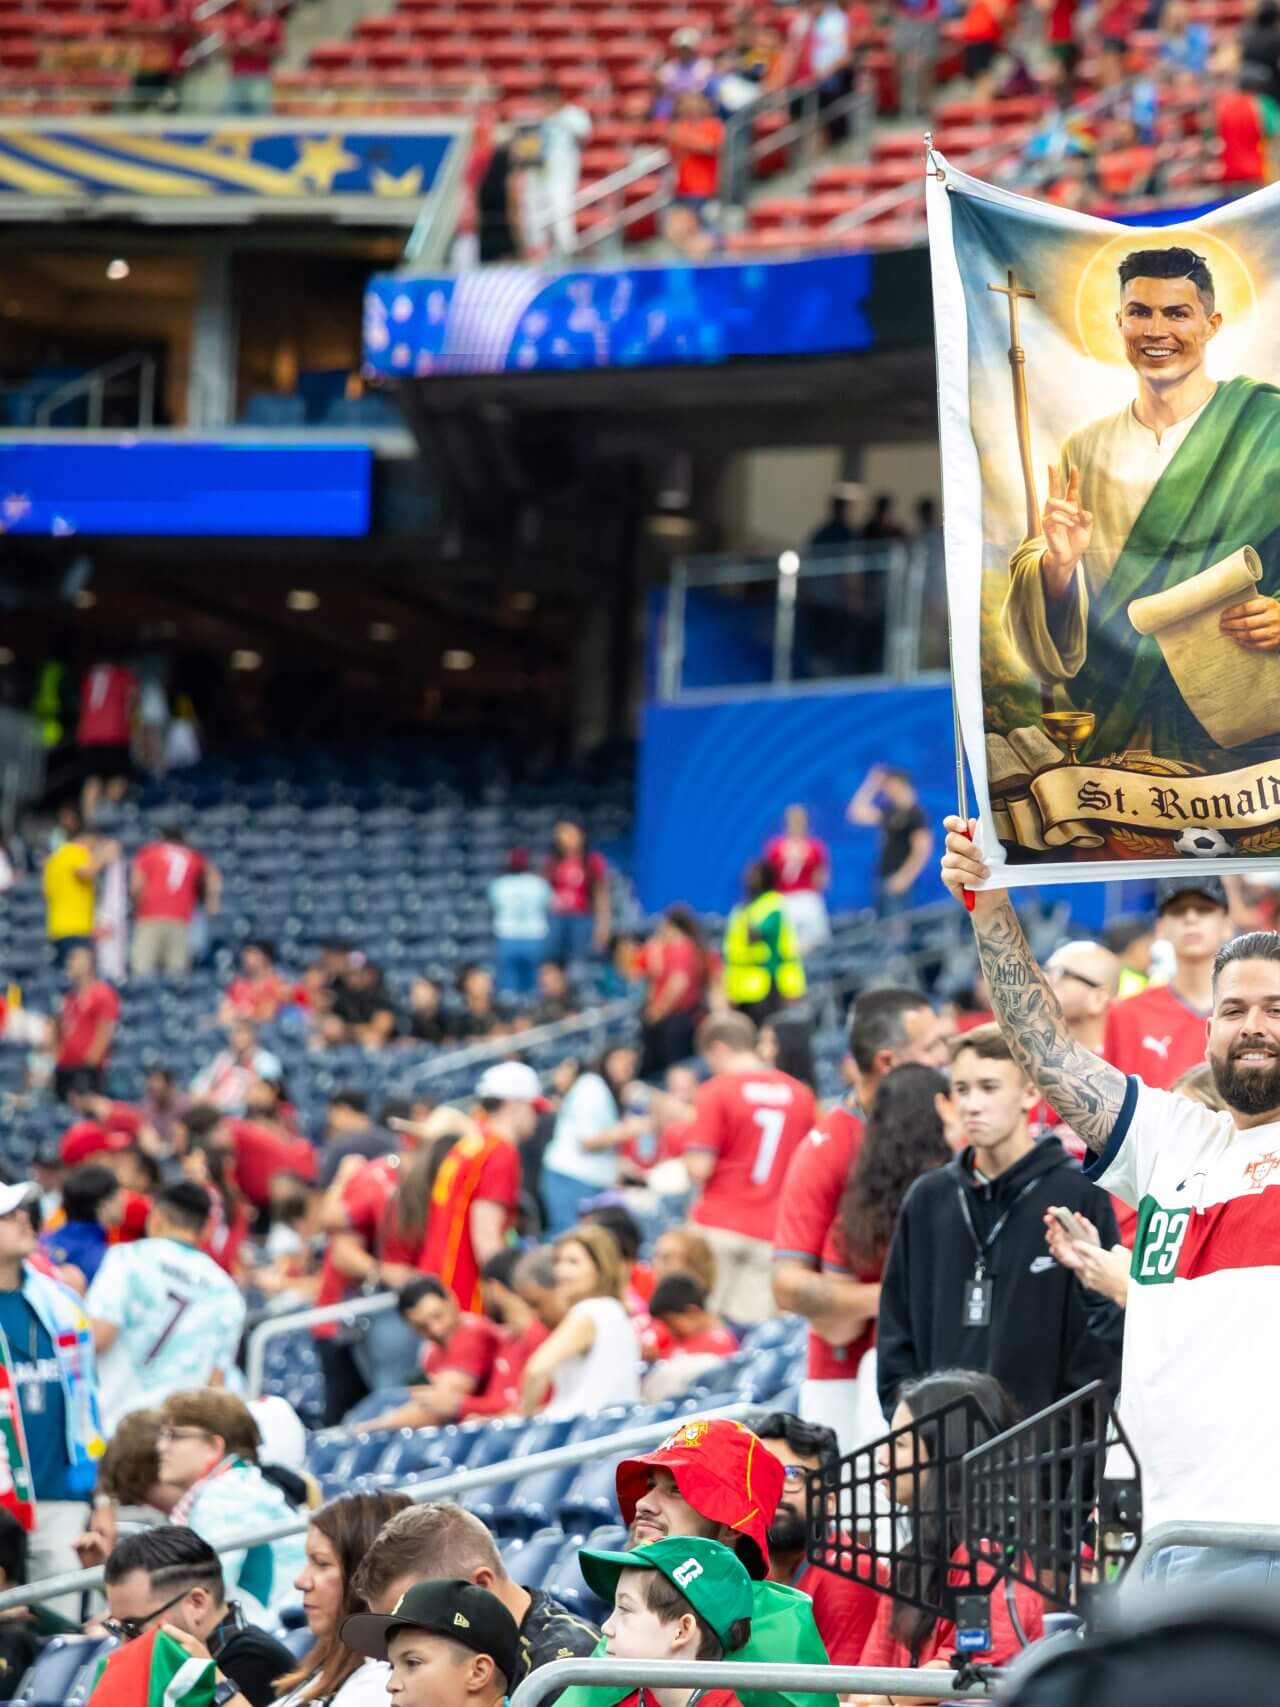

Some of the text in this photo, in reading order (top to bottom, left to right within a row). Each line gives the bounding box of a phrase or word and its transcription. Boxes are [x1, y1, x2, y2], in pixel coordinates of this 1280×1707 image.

[1077, 780, 1139, 816] St.
[1140, 1210, 1189, 1276] 23
[143, 1288, 189, 1365] 7
